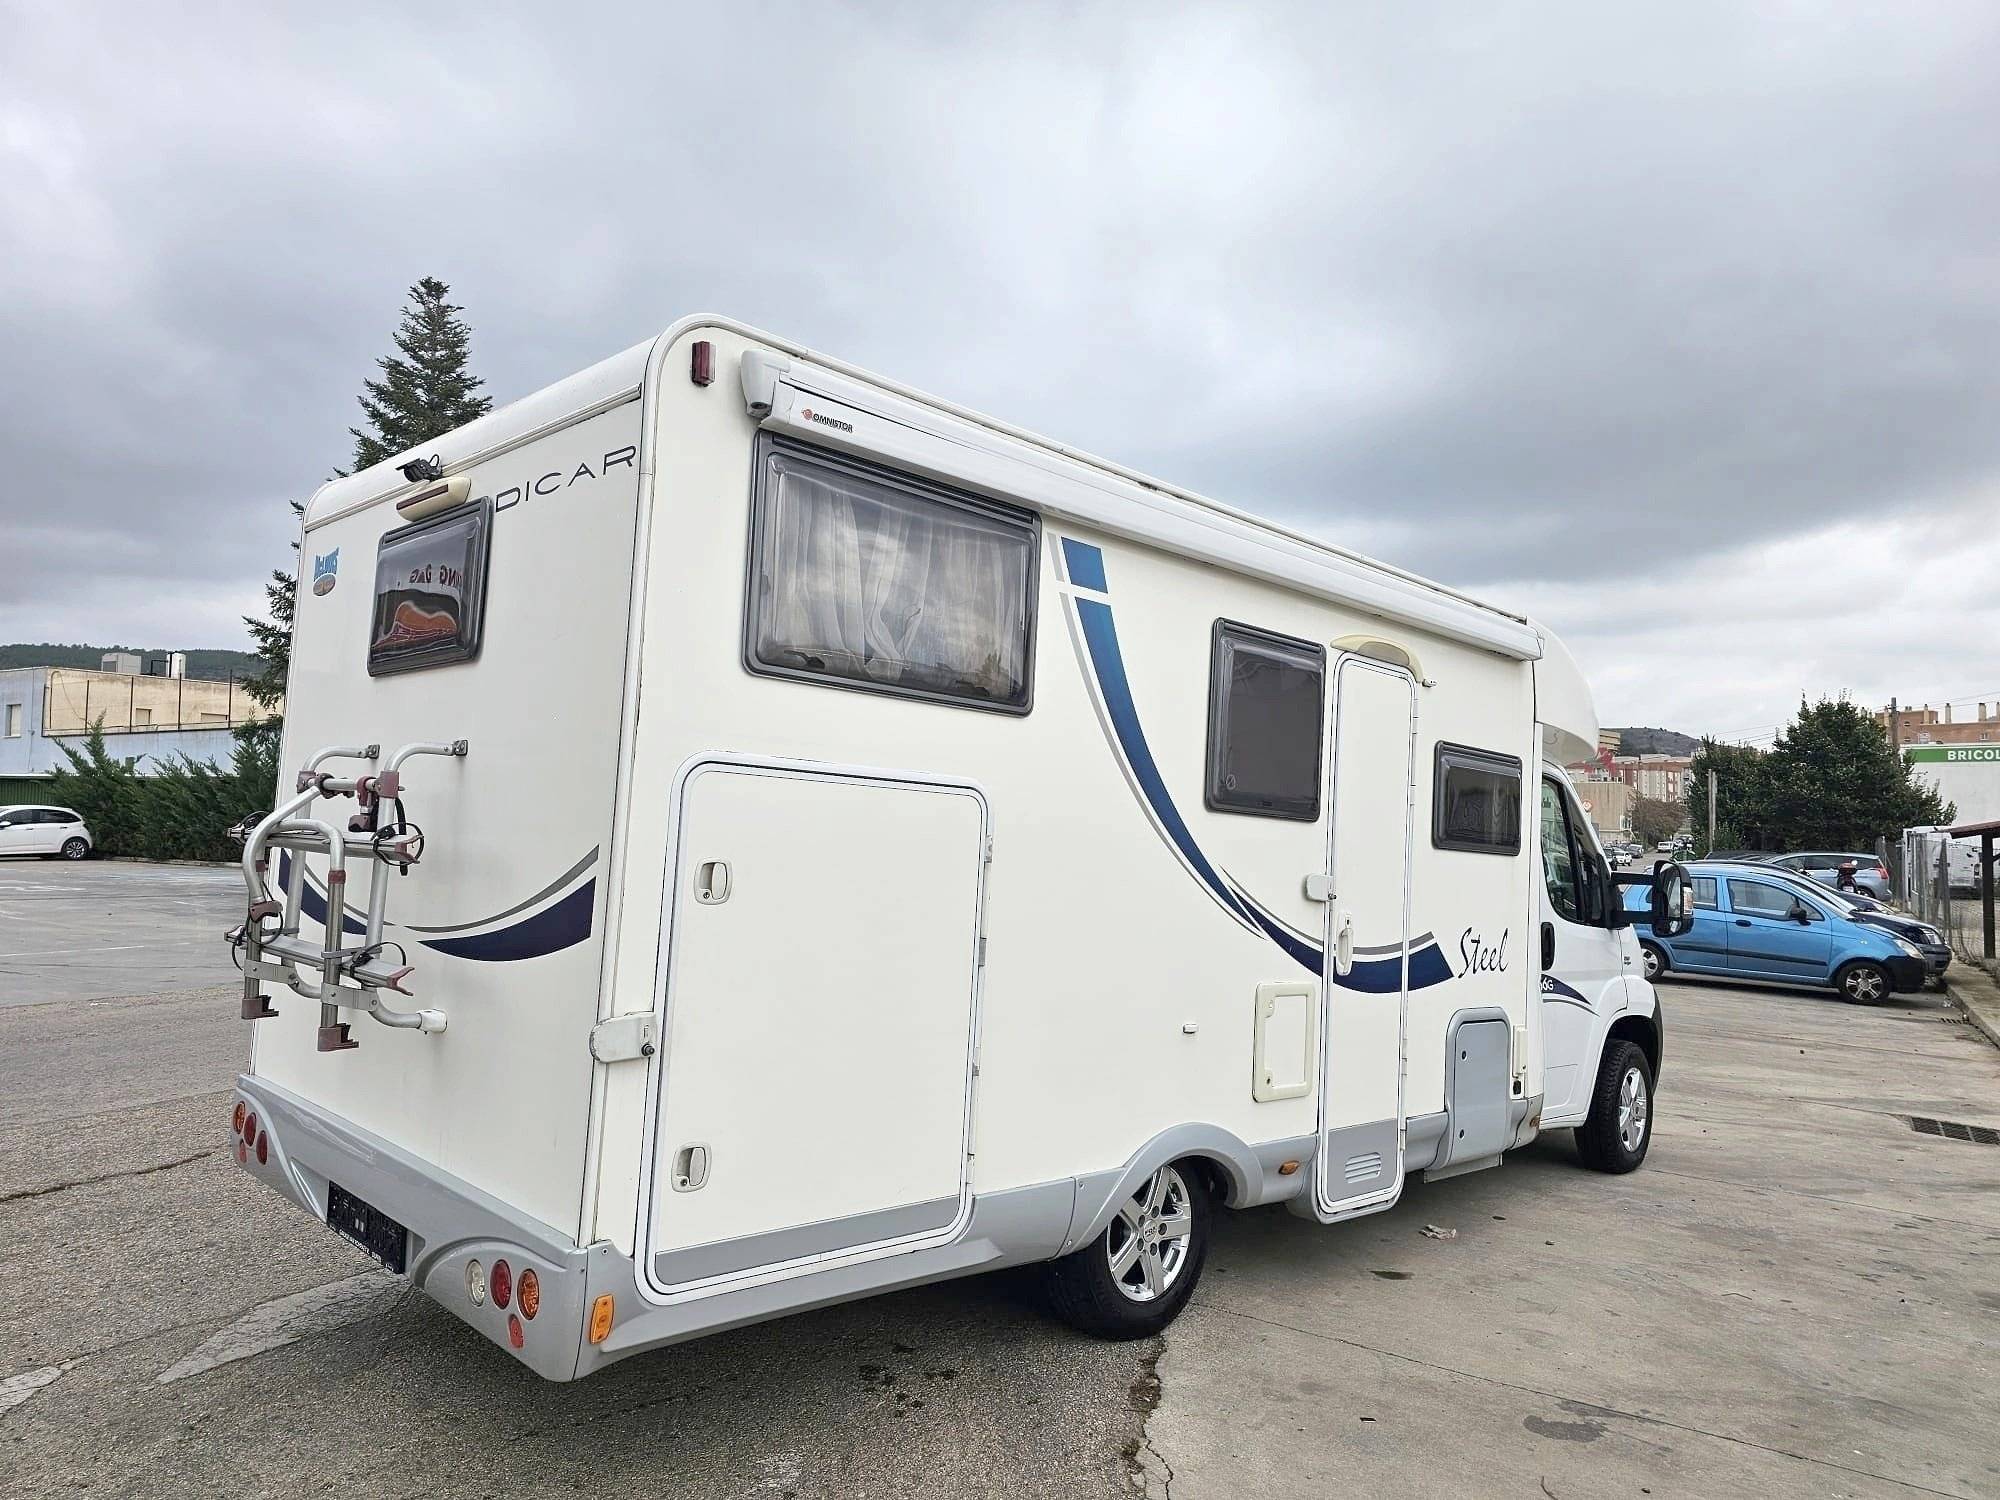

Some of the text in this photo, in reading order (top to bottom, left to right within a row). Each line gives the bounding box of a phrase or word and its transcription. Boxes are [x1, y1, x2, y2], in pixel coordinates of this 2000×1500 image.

[813, 413, 853, 433] OMNISTOR
[495, 445, 636, 513] DICAR
[1947, 749, 2000, 761] BRICOL
[1458, 926, 1508, 979] Steel
